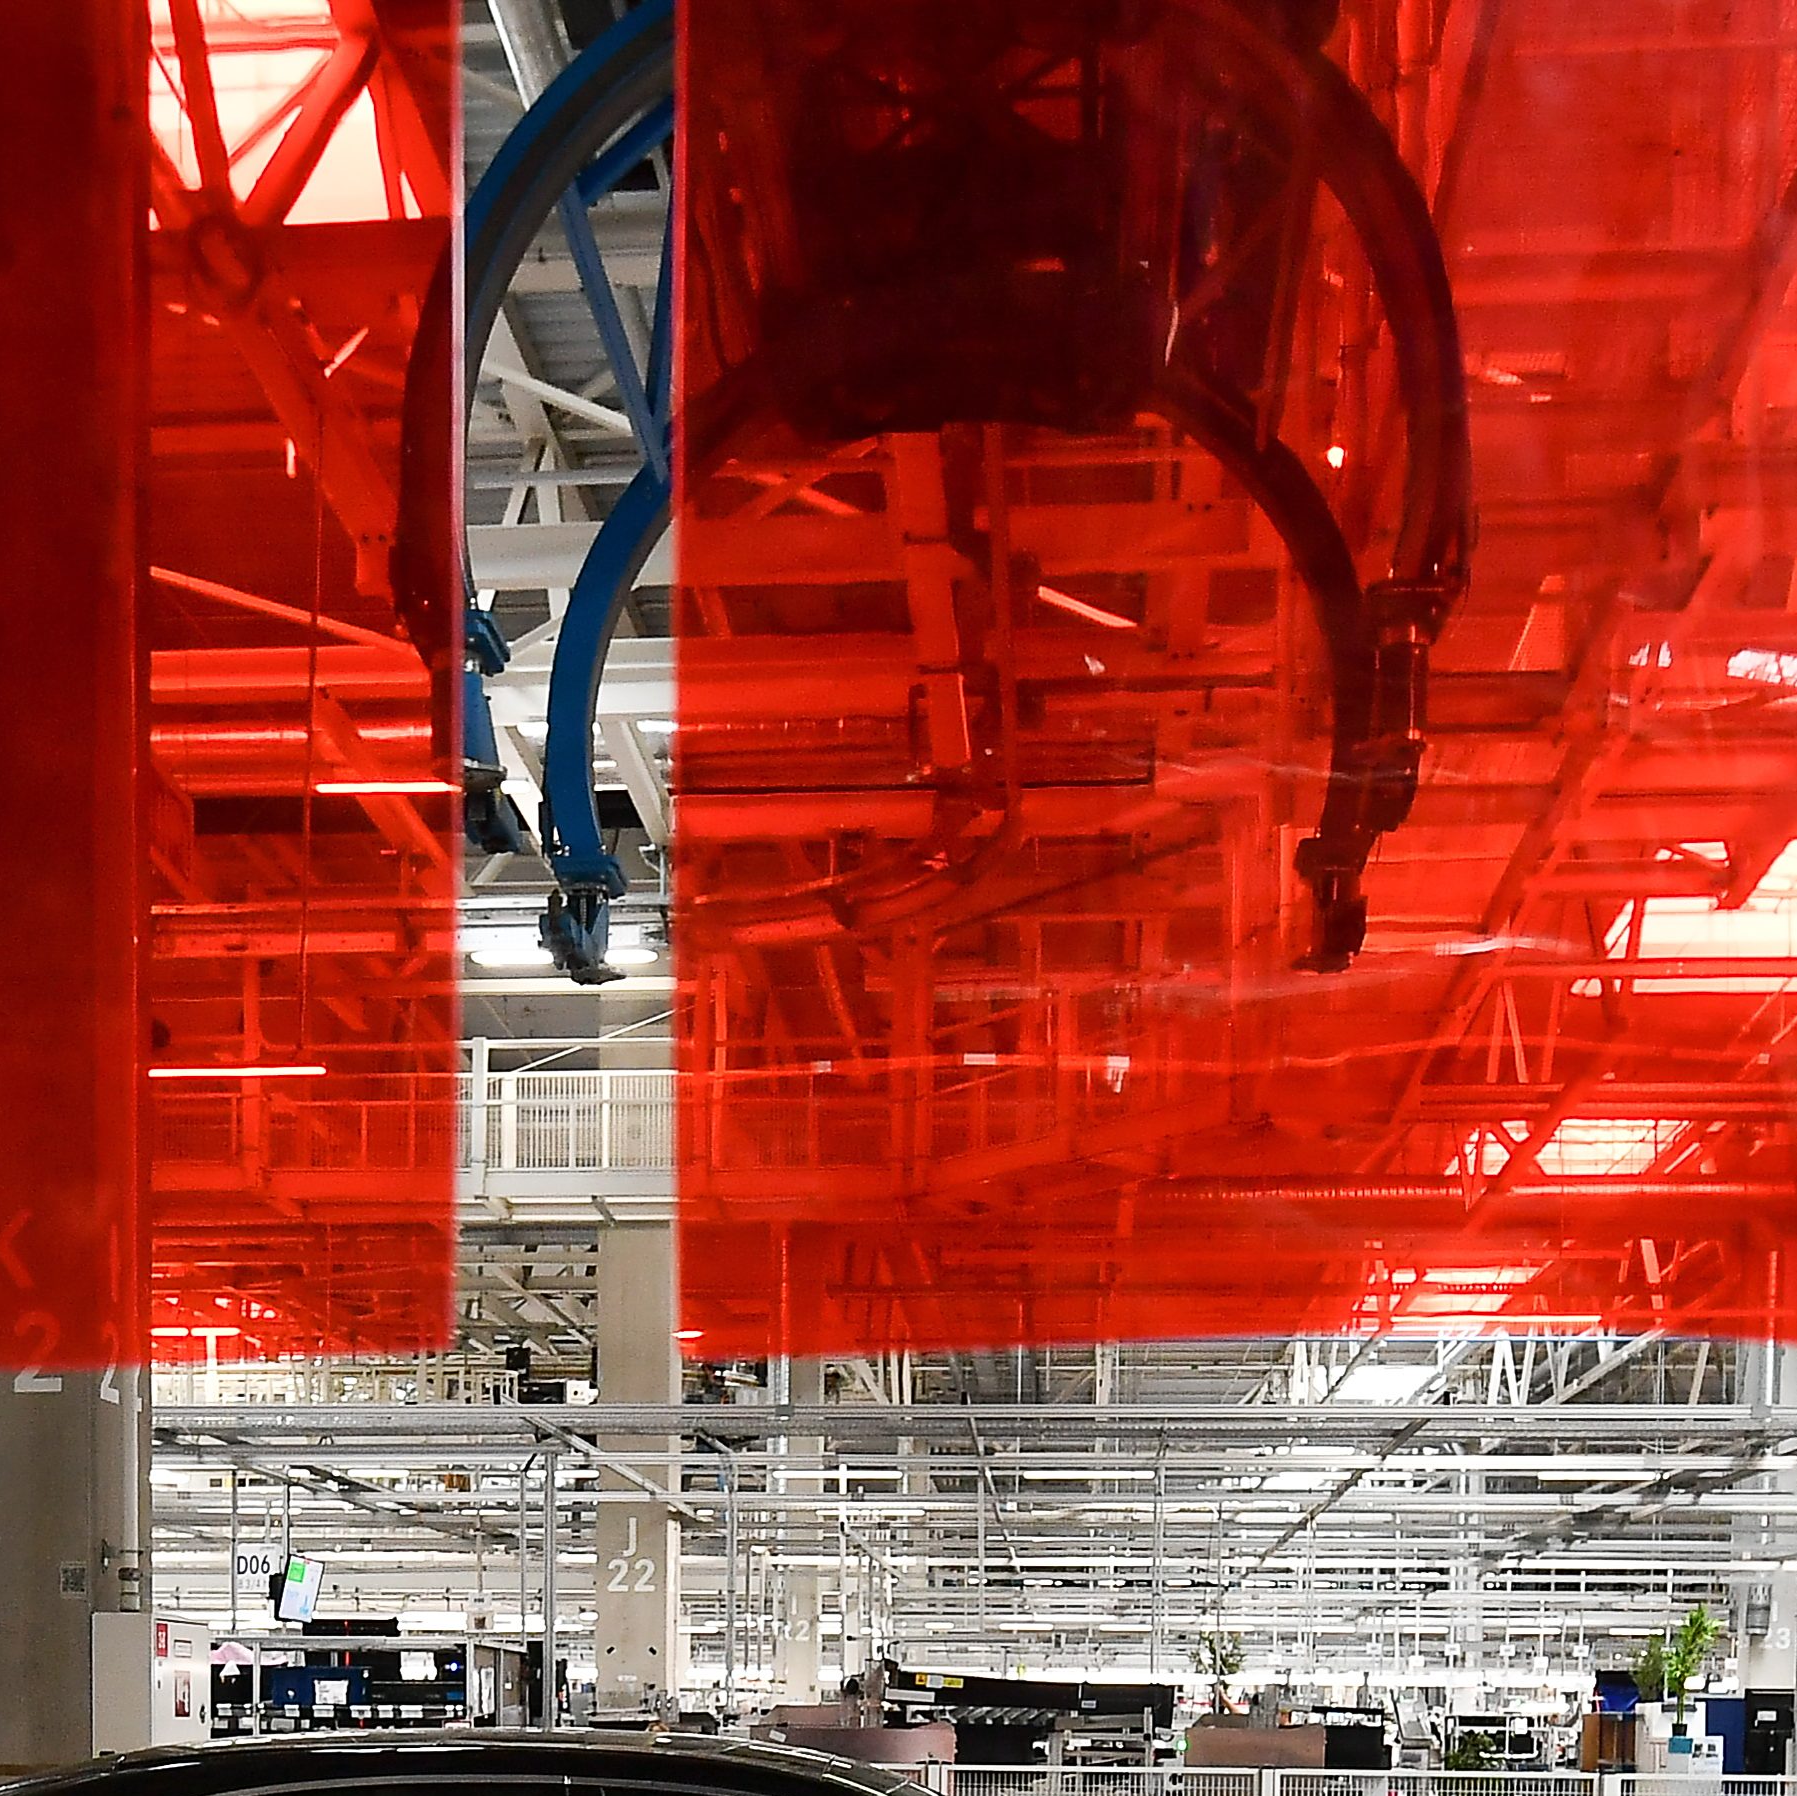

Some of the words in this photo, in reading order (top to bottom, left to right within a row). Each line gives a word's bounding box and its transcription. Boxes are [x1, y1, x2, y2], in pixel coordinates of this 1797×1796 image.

[623, 1517, 637, 1557] J
[237, 1555, 270, 1574] D06
[607, 1559, 656, 1593] 22
